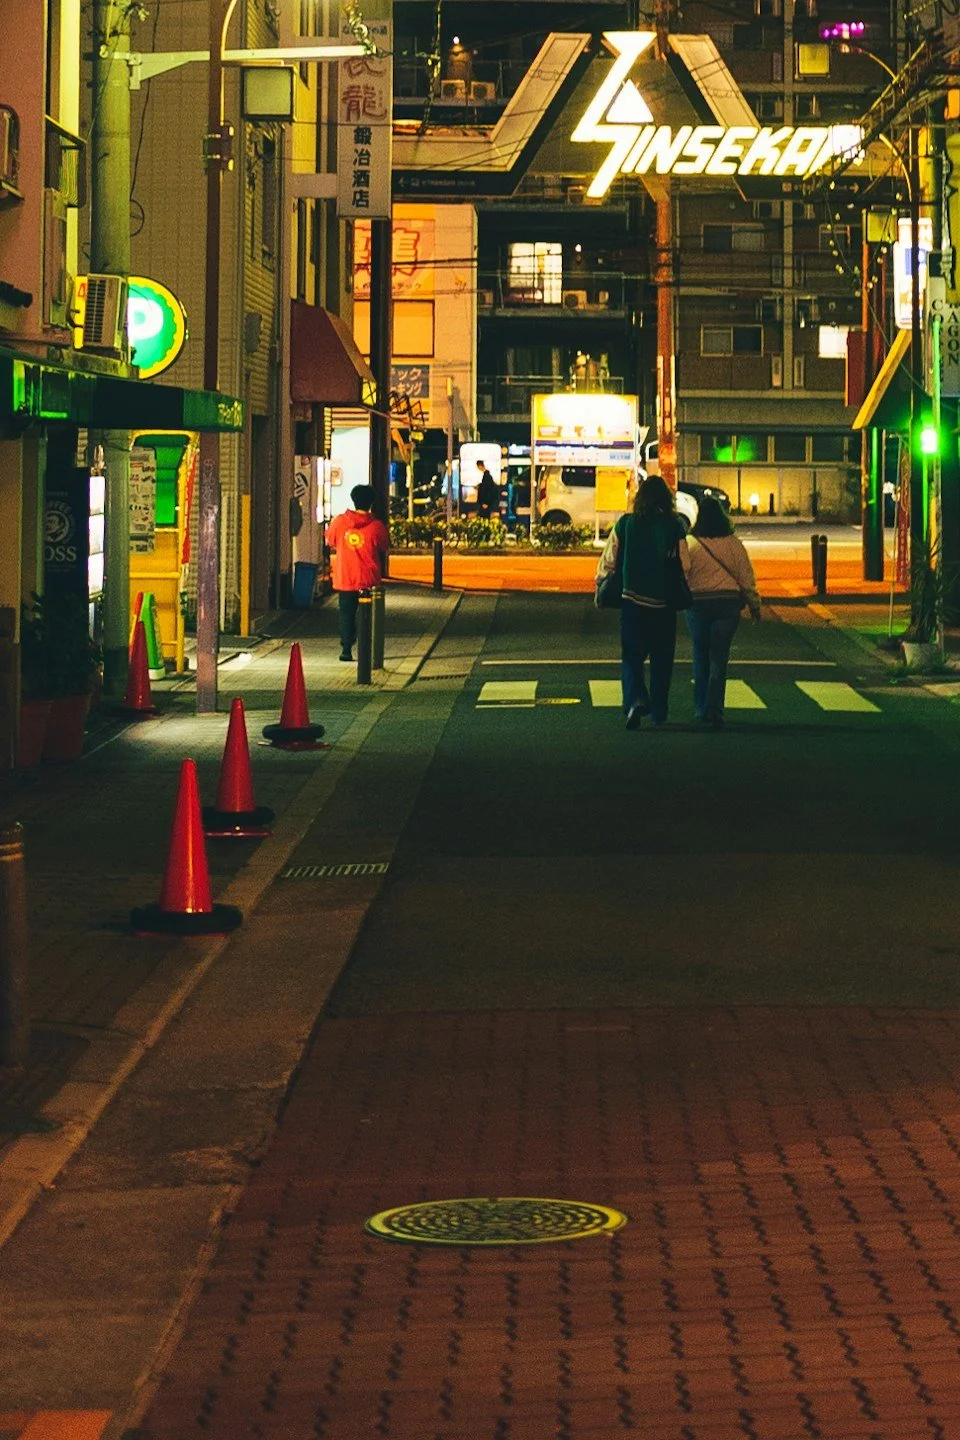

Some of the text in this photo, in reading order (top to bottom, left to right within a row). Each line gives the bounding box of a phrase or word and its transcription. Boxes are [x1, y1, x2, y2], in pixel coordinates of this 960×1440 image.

[351, 126, 373, 209] 鍛冶酒店
[44, 545, 78, 563] OSS
